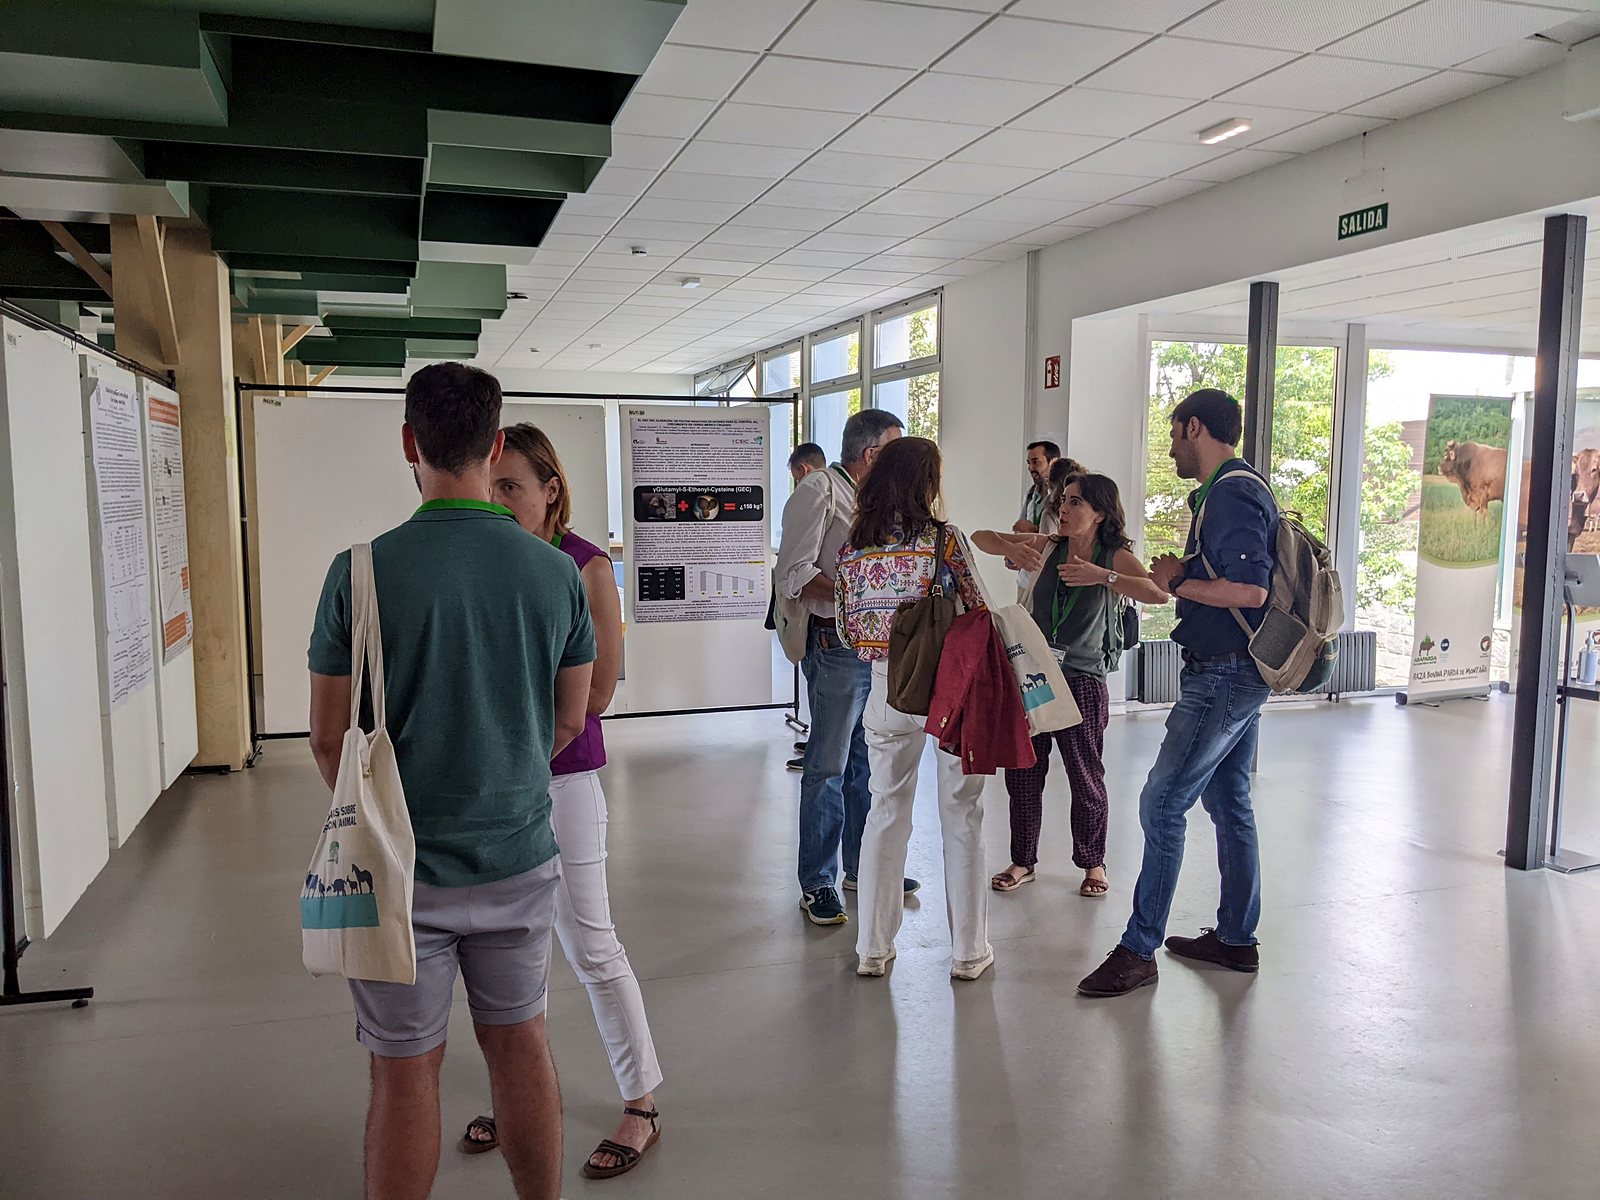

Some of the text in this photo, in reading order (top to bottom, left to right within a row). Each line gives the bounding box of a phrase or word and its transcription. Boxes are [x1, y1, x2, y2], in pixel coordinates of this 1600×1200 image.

[1341, 208, 1383, 236] SALIDA
[1413, 672, 1426, 680] RAZA
[1443, 668, 1459, 677] PARDA
[340, 804, 356, 815] SOBRE
[338, 815, 357, 828] ANIMAL
